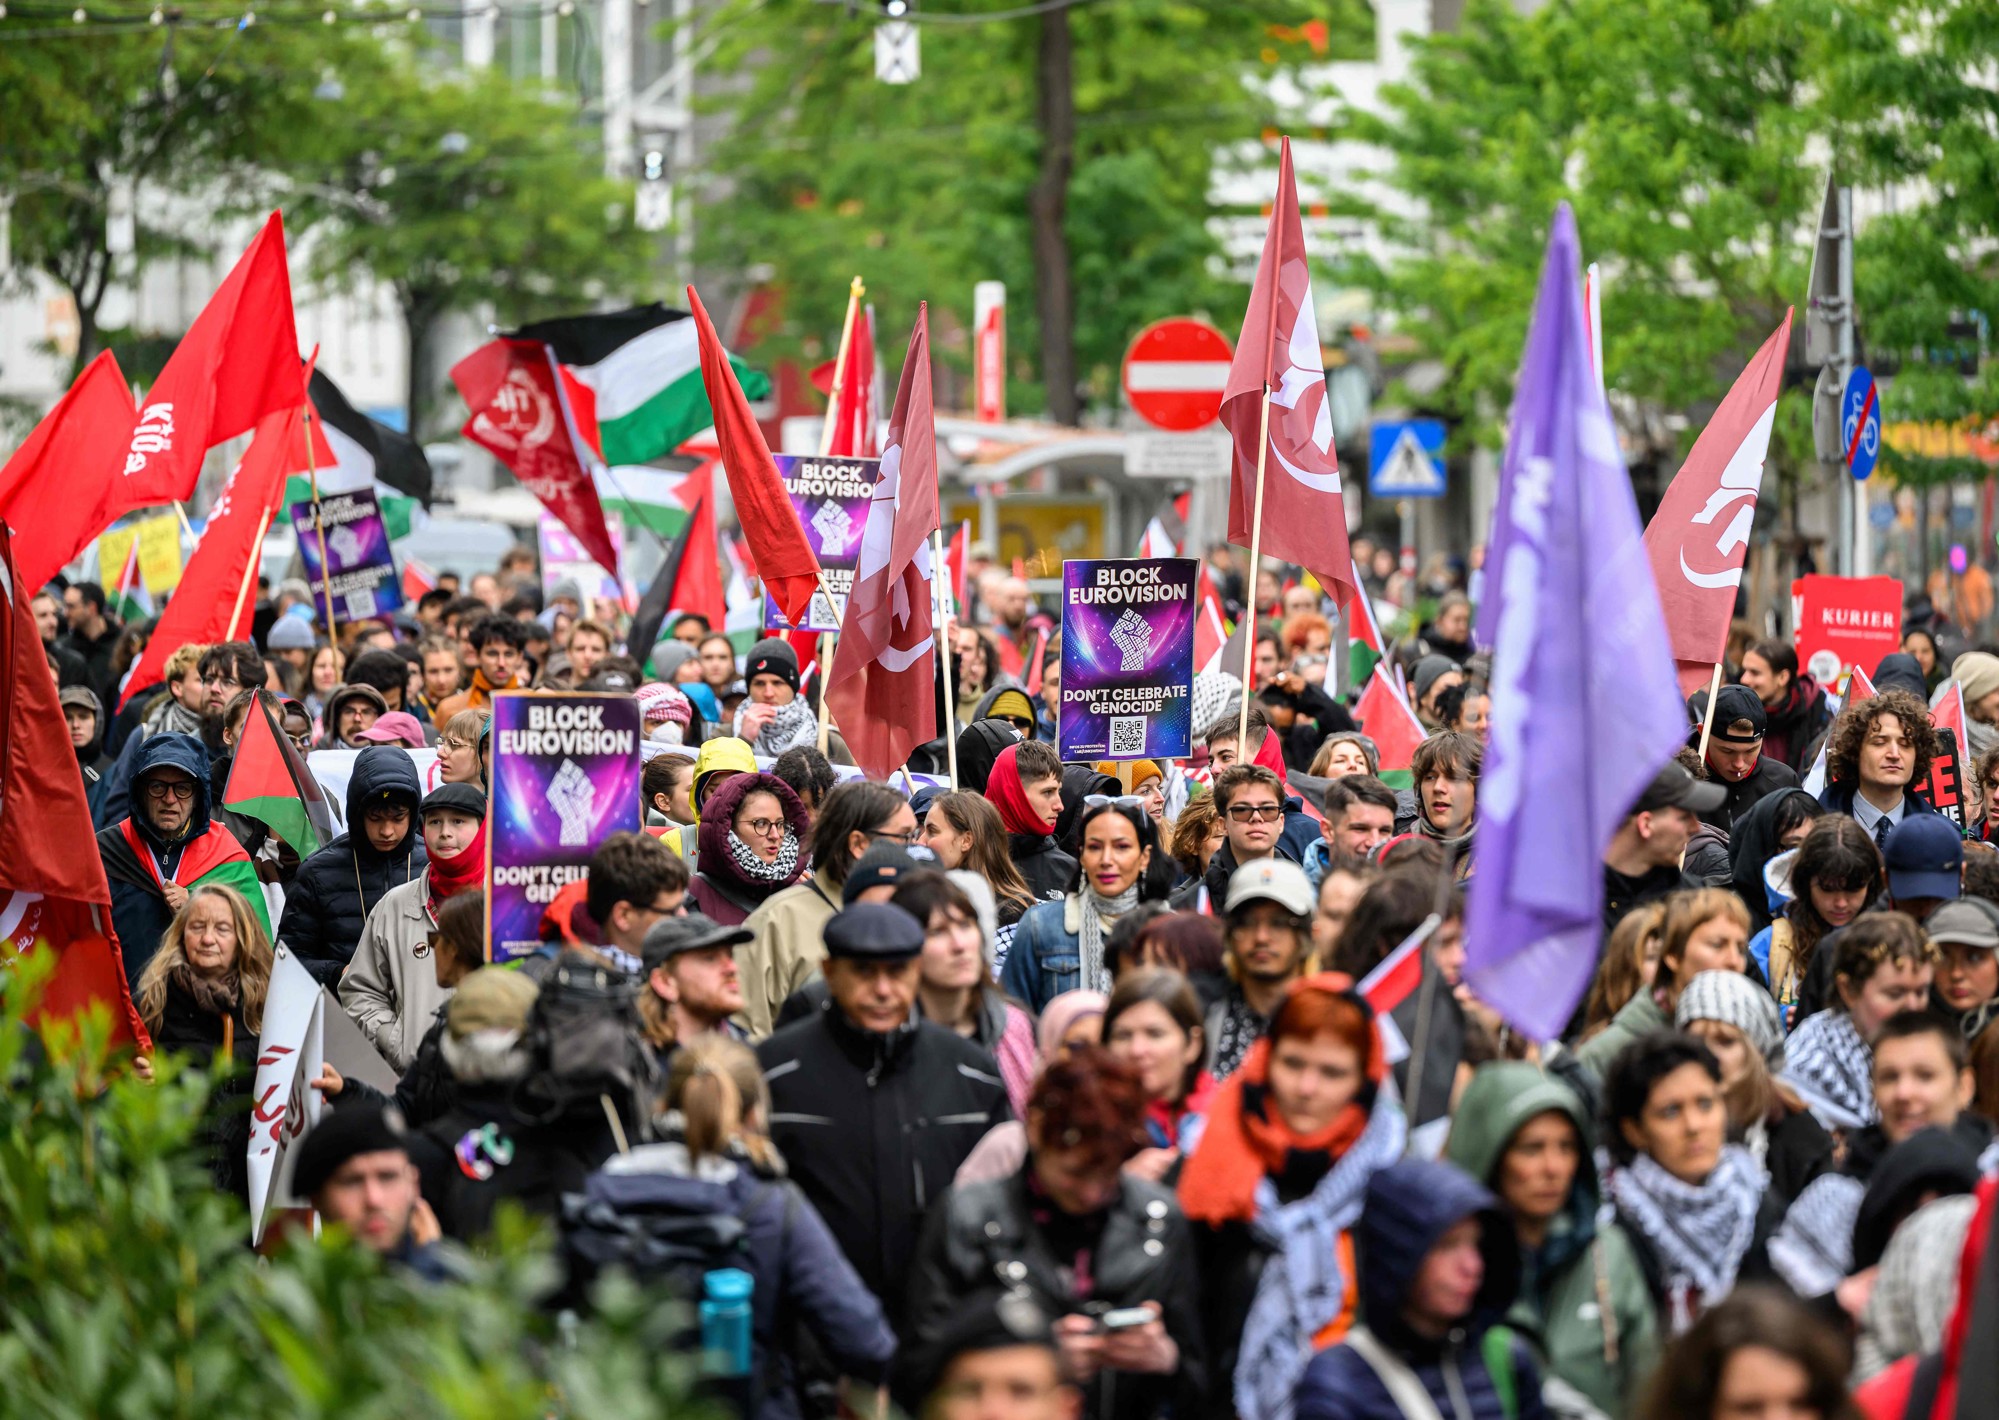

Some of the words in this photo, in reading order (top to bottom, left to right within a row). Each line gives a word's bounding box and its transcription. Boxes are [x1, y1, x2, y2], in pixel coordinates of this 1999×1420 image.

[801, 463, 864, 482] BLOCK
[784, 478, 875, 498] UROVISIO
[1096, 566, 1162, 587] BLOCK
[1069, 583, 1188, 605] EUROVISION
[1822, 608, 1894, 628] KURIER
[1063, 688, 1110, 702] DON'T
[1112, 685, 1188, 701] CELEBRATE
[1089, 700, 1163, 714] GENOCIDE
[528, 705, 605, 731] BLOCK
[498, 729, 635, 756] EUROVISION
[493, 865, 551, 886] DON'T
